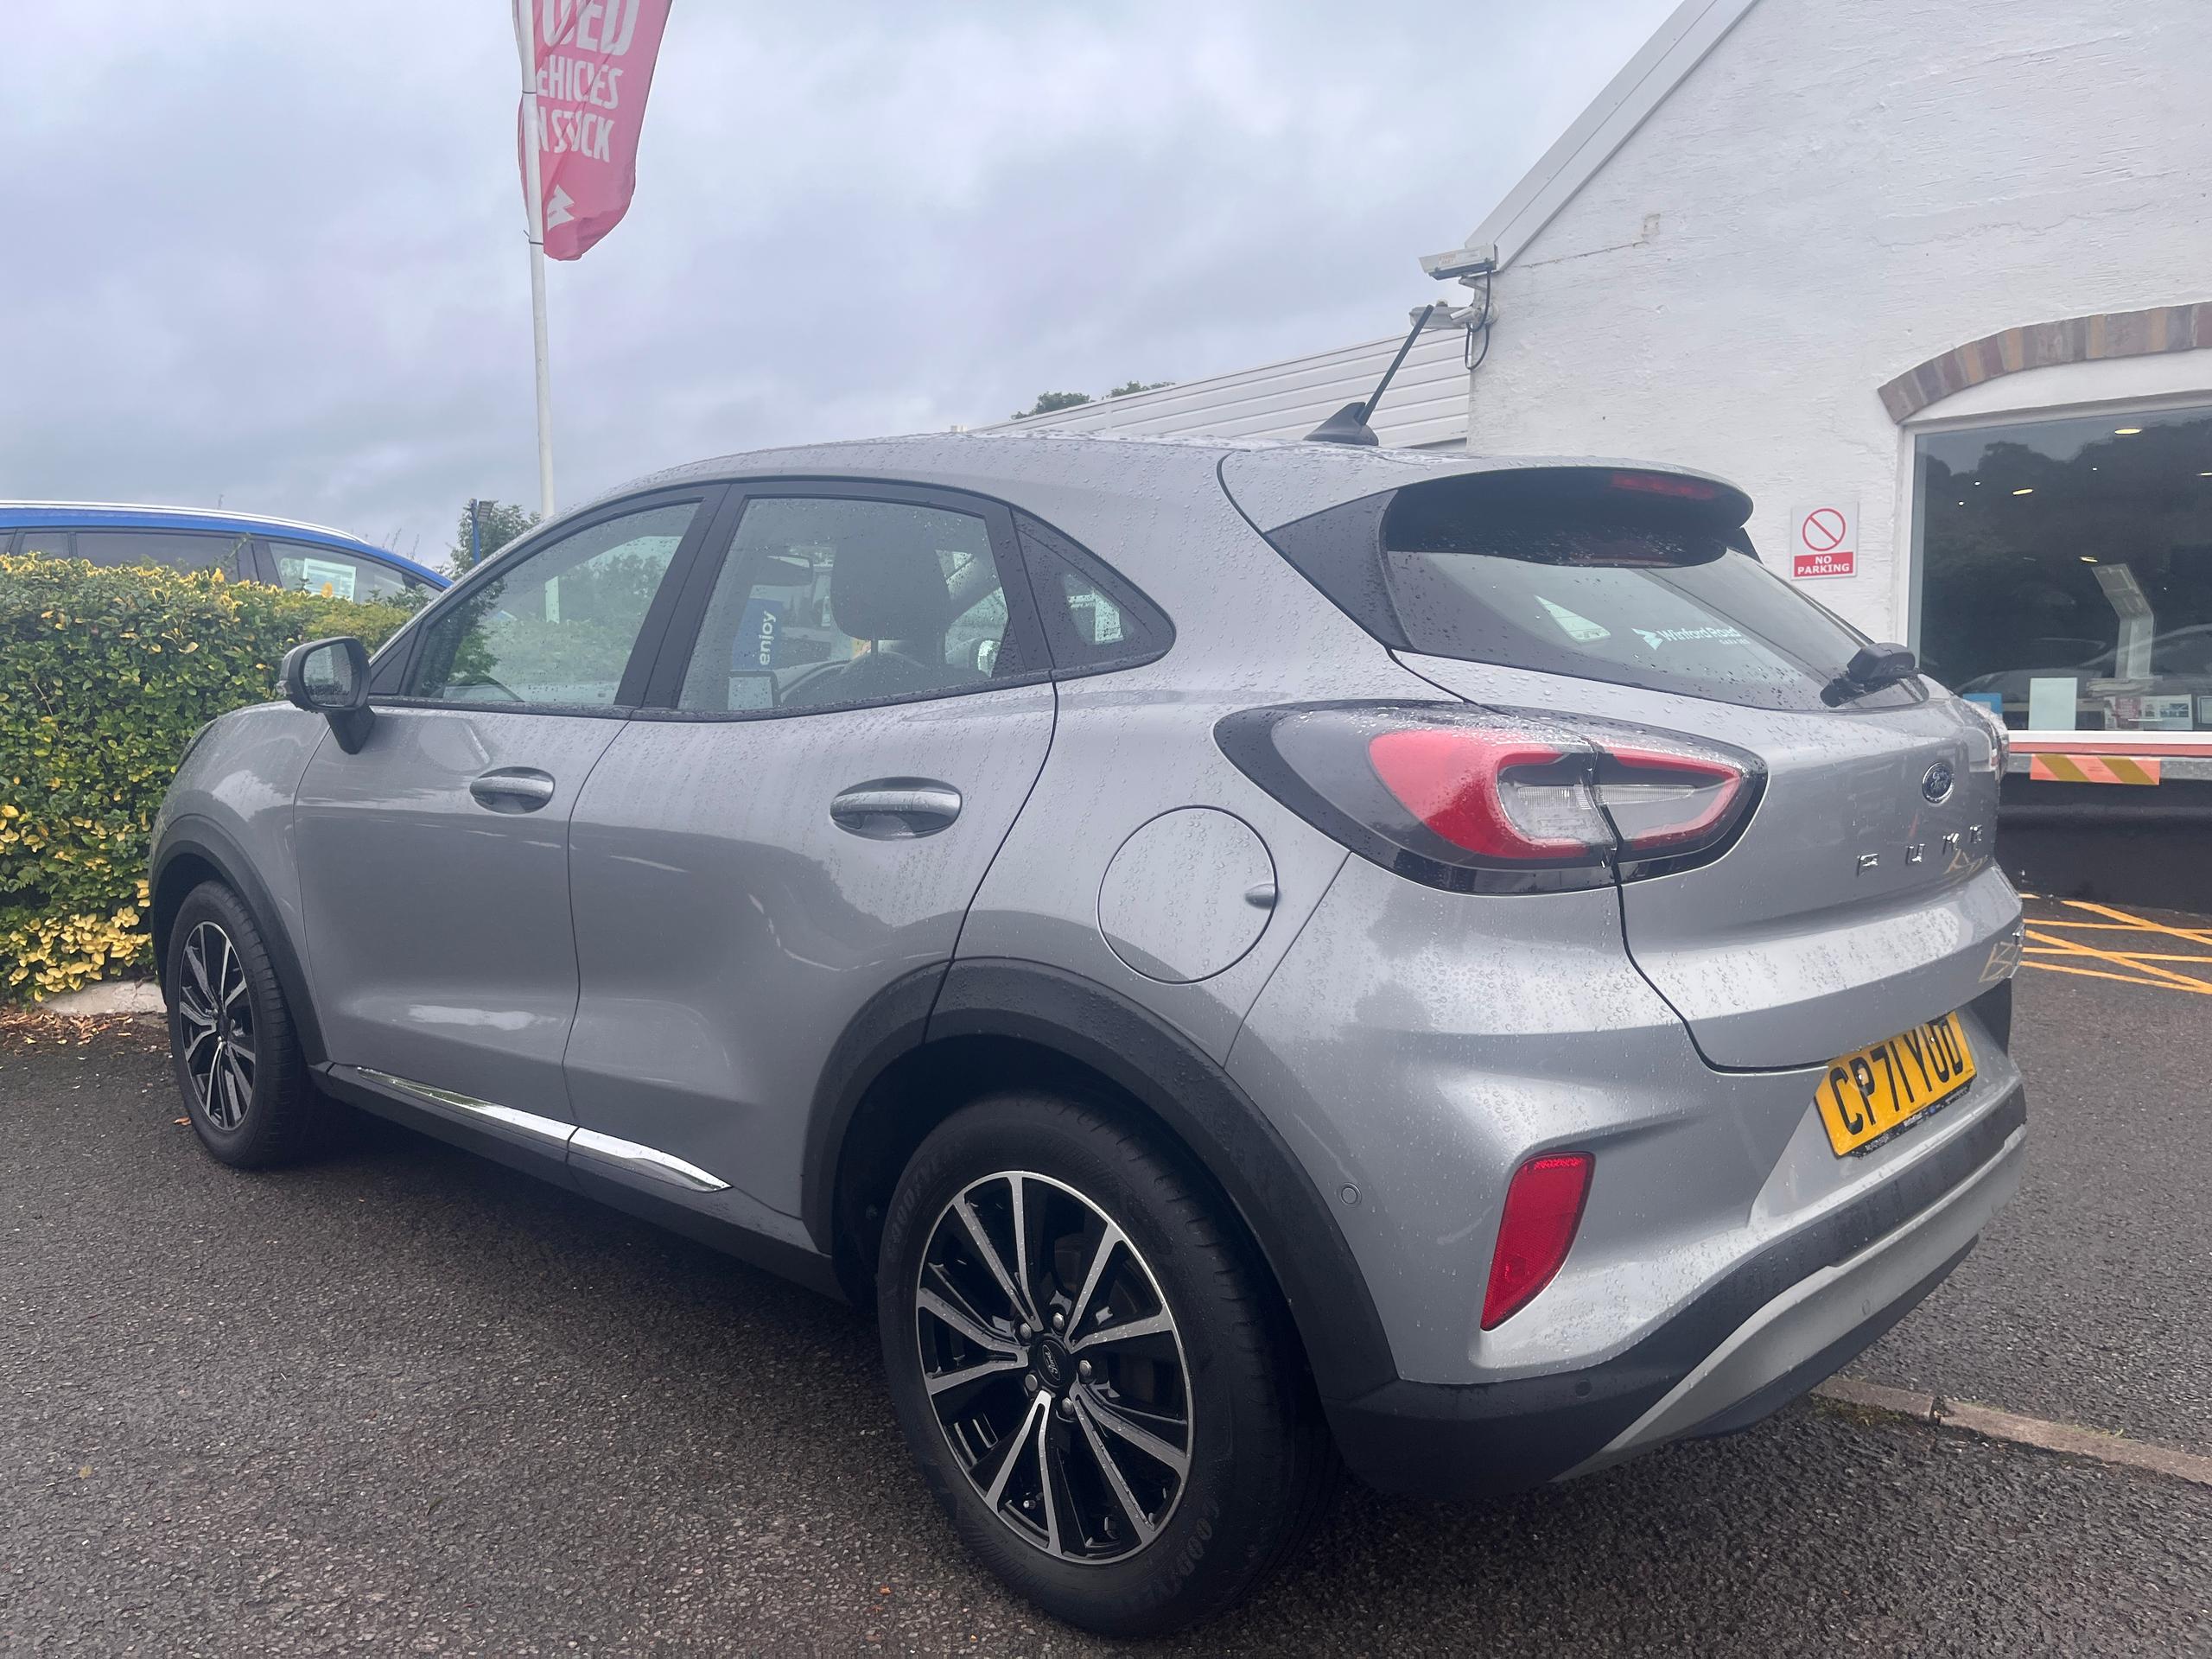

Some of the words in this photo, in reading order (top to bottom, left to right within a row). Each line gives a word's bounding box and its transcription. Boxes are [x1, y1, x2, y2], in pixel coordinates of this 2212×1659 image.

[537, 54, 624, 110] EHICLES
[1797, 563, 1850, 575] PARKING
[1815, 556, 1832, 564] NO
[759, 610, 777, 665] enjoy
